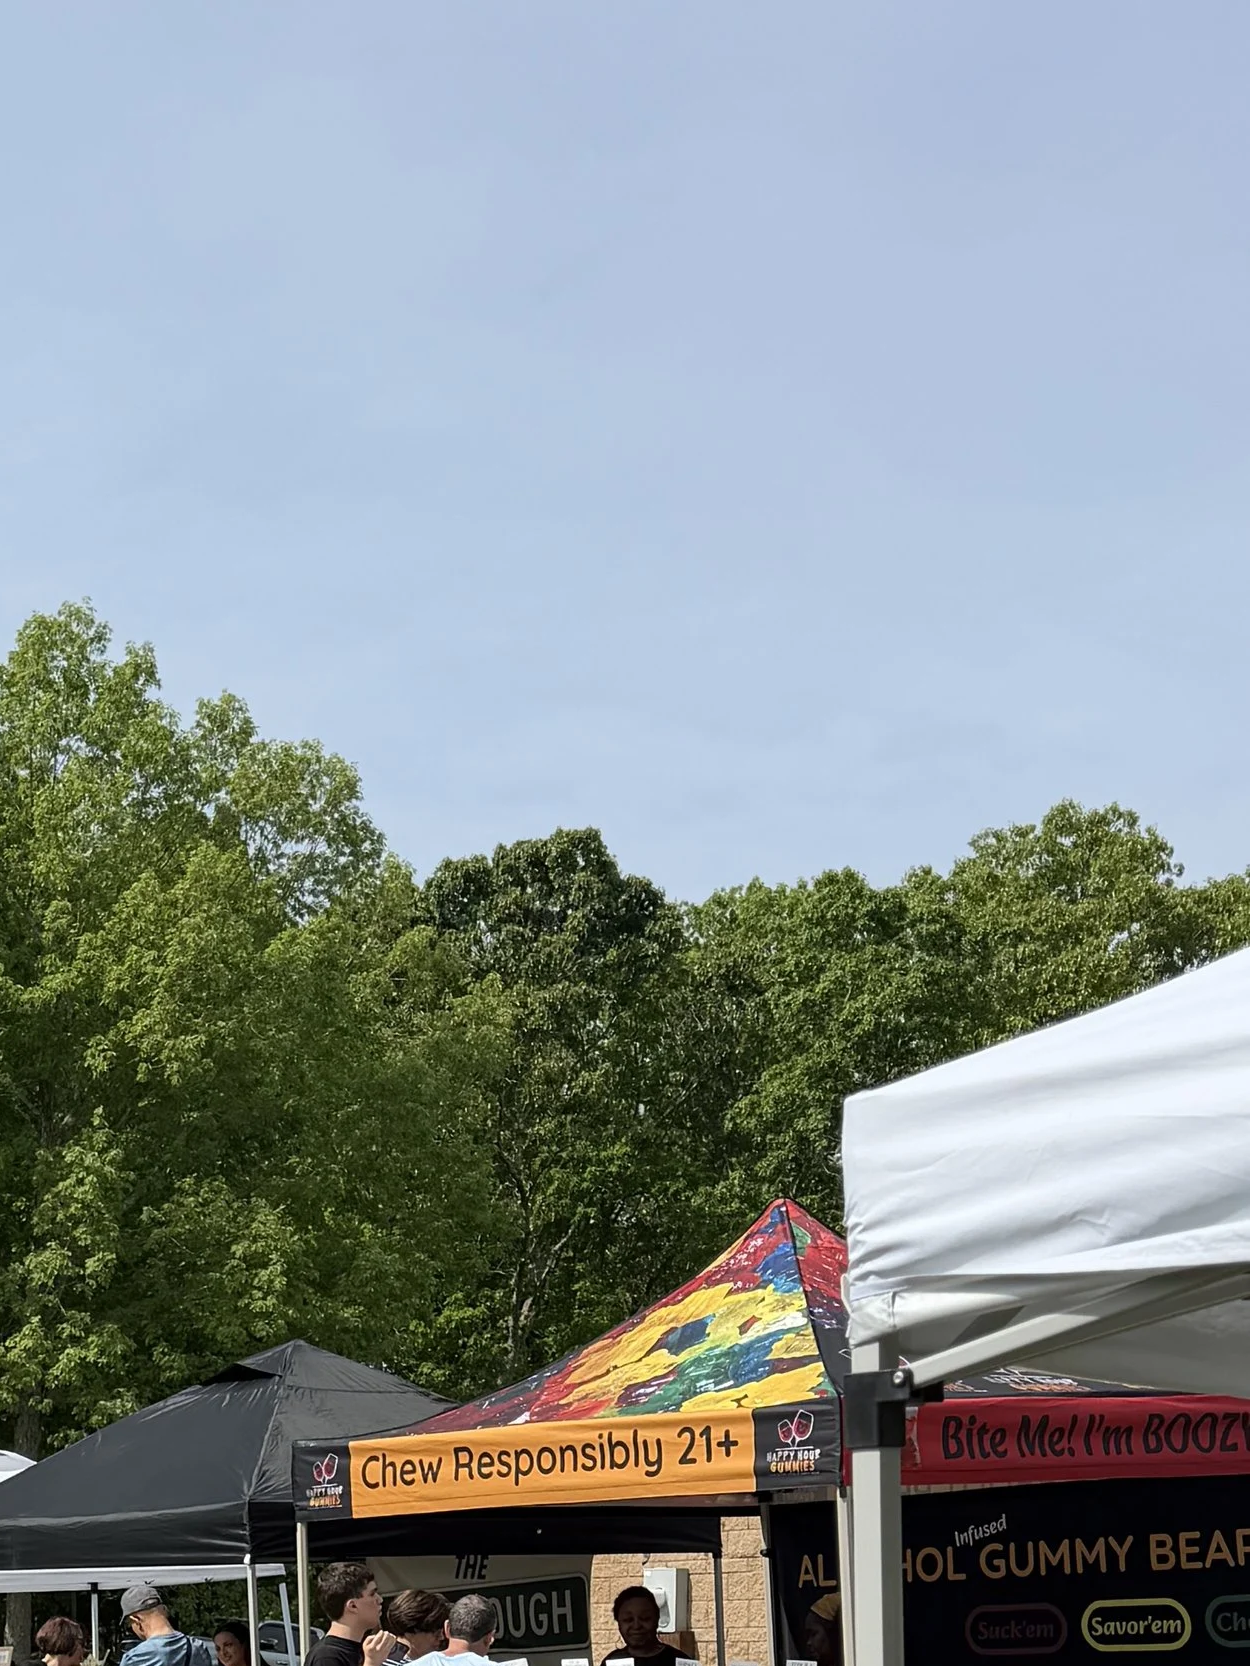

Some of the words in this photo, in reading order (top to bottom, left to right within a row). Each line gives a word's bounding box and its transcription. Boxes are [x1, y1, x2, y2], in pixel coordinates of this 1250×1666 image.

[941, 1414, 1008, 1460] Bite
[1016, 1414, 1078, 1459] Me!
[1084, 1413, 1134, 1457] I'm
[361, 1453, 443, 1490] Chew
[453, 1427, 663, 1487] Responsibly
[676, 1424, 739, 1466] 21+
[766, 1450, 795, 1463] HAPPY
[797, 1448, 821, 1461] HOUR
[770, 1460, 815, 1473] GUMMIES
[954, 1513, 1007, 1548] Infused
[454, 1554, 490, 1580] THE
[979, 1535, 1134, 1579] GUMMY
[977, 1619, 1054, 1640] Suck'em
[1091, 1615, 1182, 1636] Savor'em
